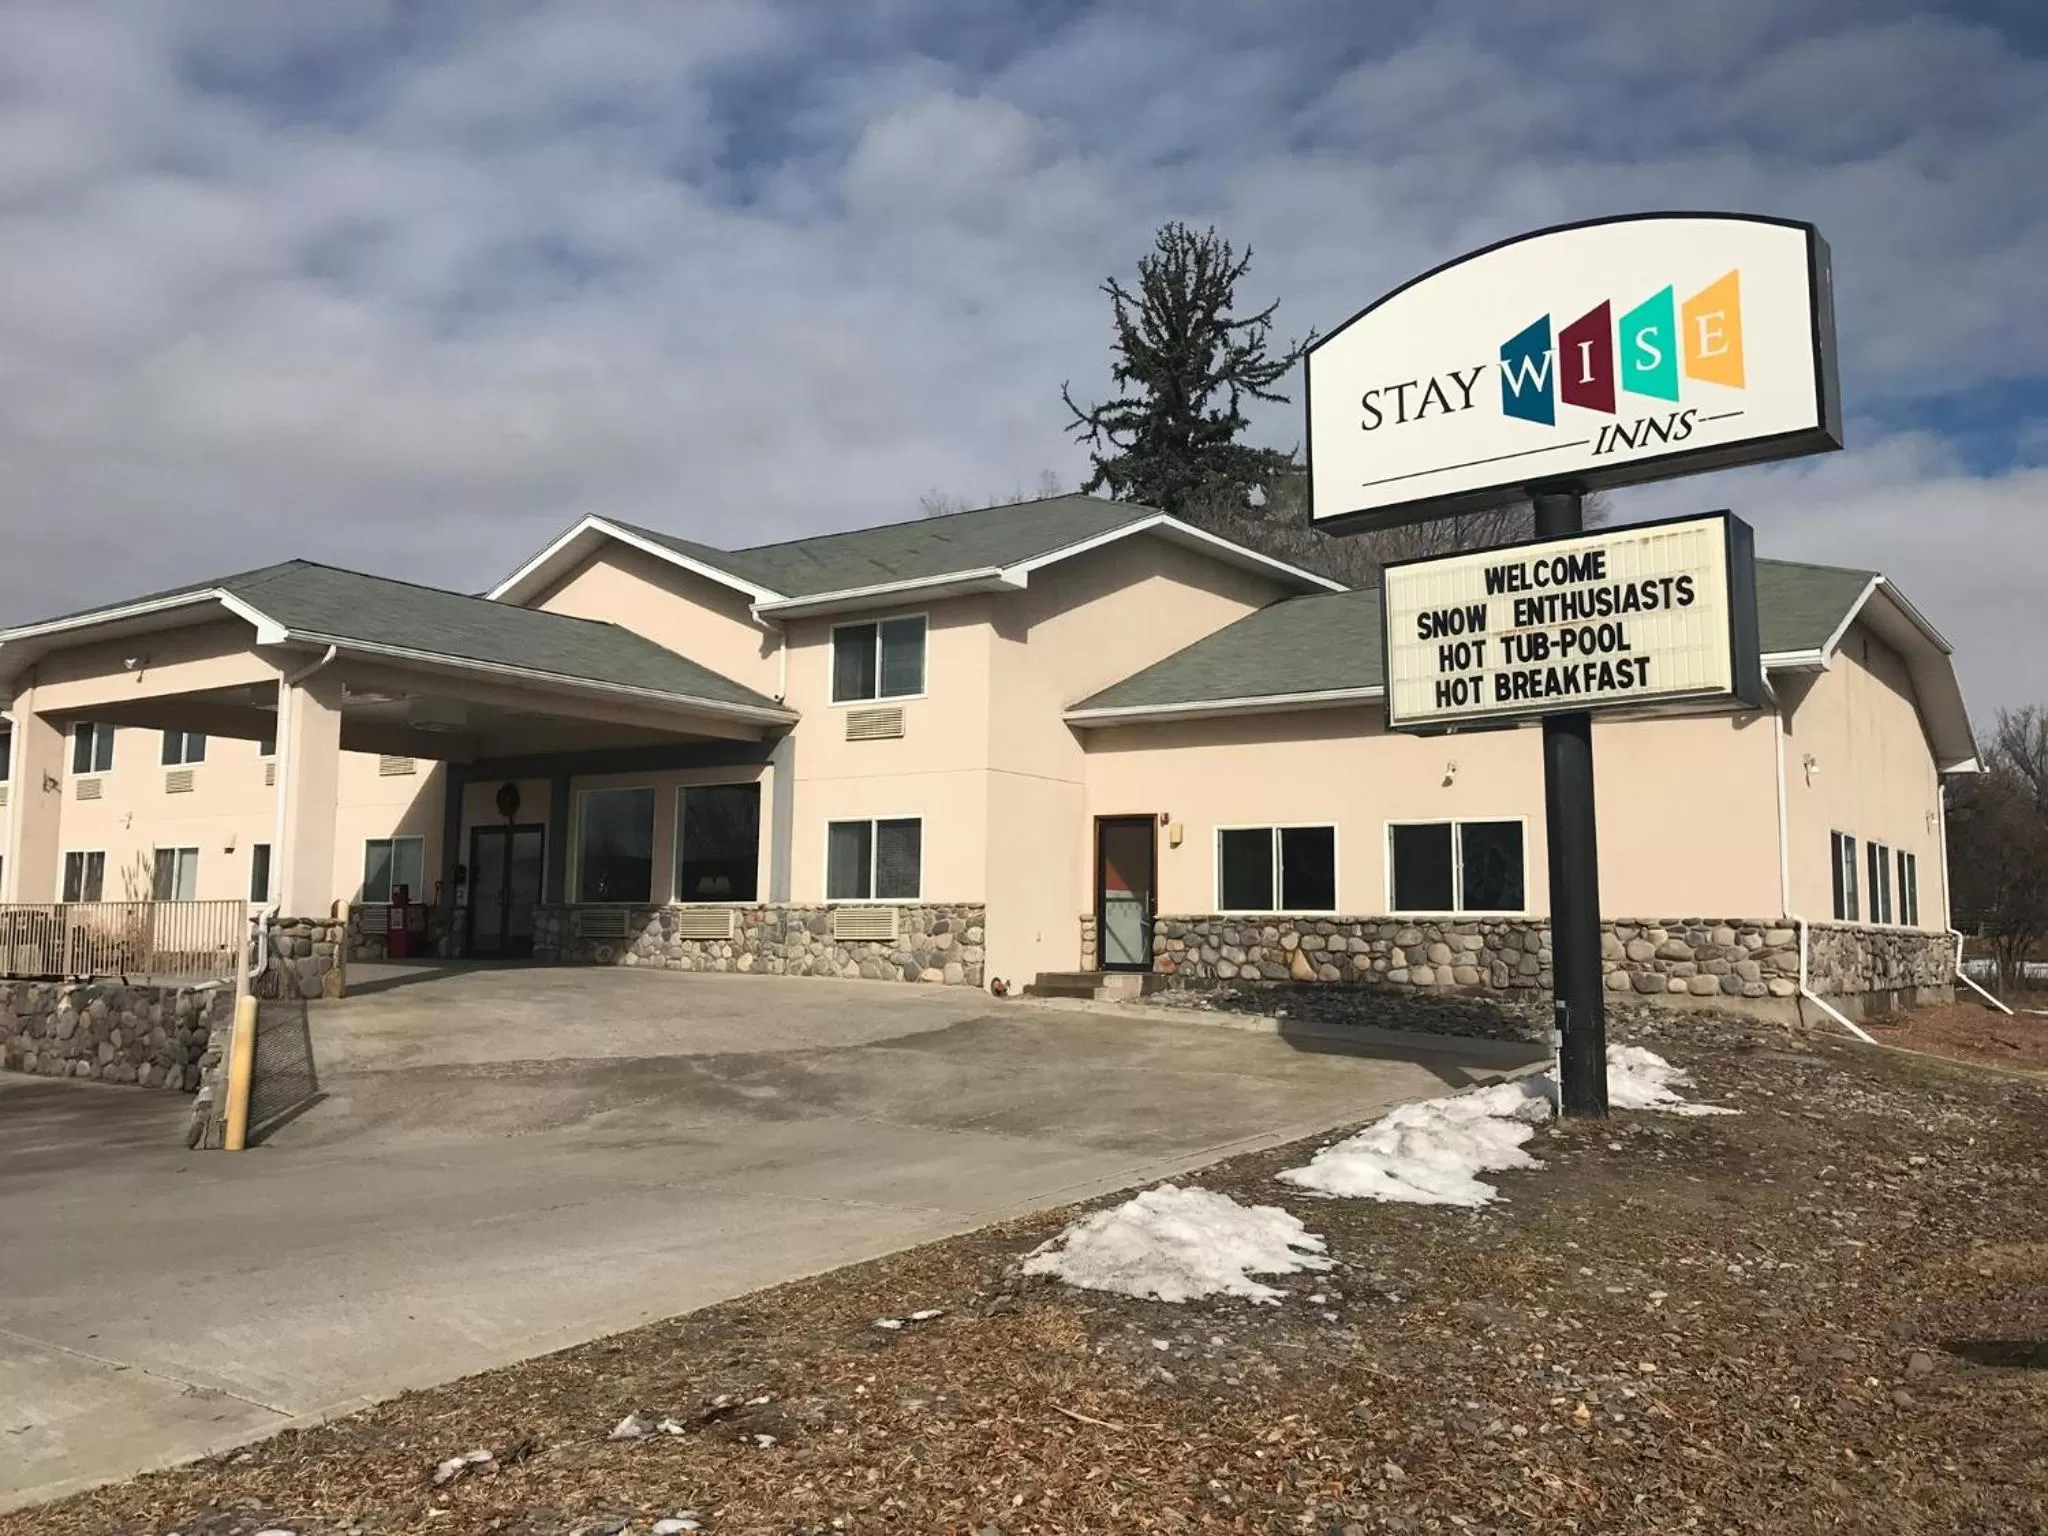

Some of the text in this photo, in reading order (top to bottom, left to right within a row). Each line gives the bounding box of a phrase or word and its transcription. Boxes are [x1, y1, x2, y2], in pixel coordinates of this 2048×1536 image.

[1360, 364, 1487, 431] STAY
[1591, 409, 1698, 456] INNS
[1484, 550, 1606, 595] WELCOME
[1416, 575, 1695, 640] SNOW ENTHUSIASTS
[1438, 622, 1631, 672] HOT TUB-POOL
[1435, 656, 1650, 708] HOT BREAKFAST
